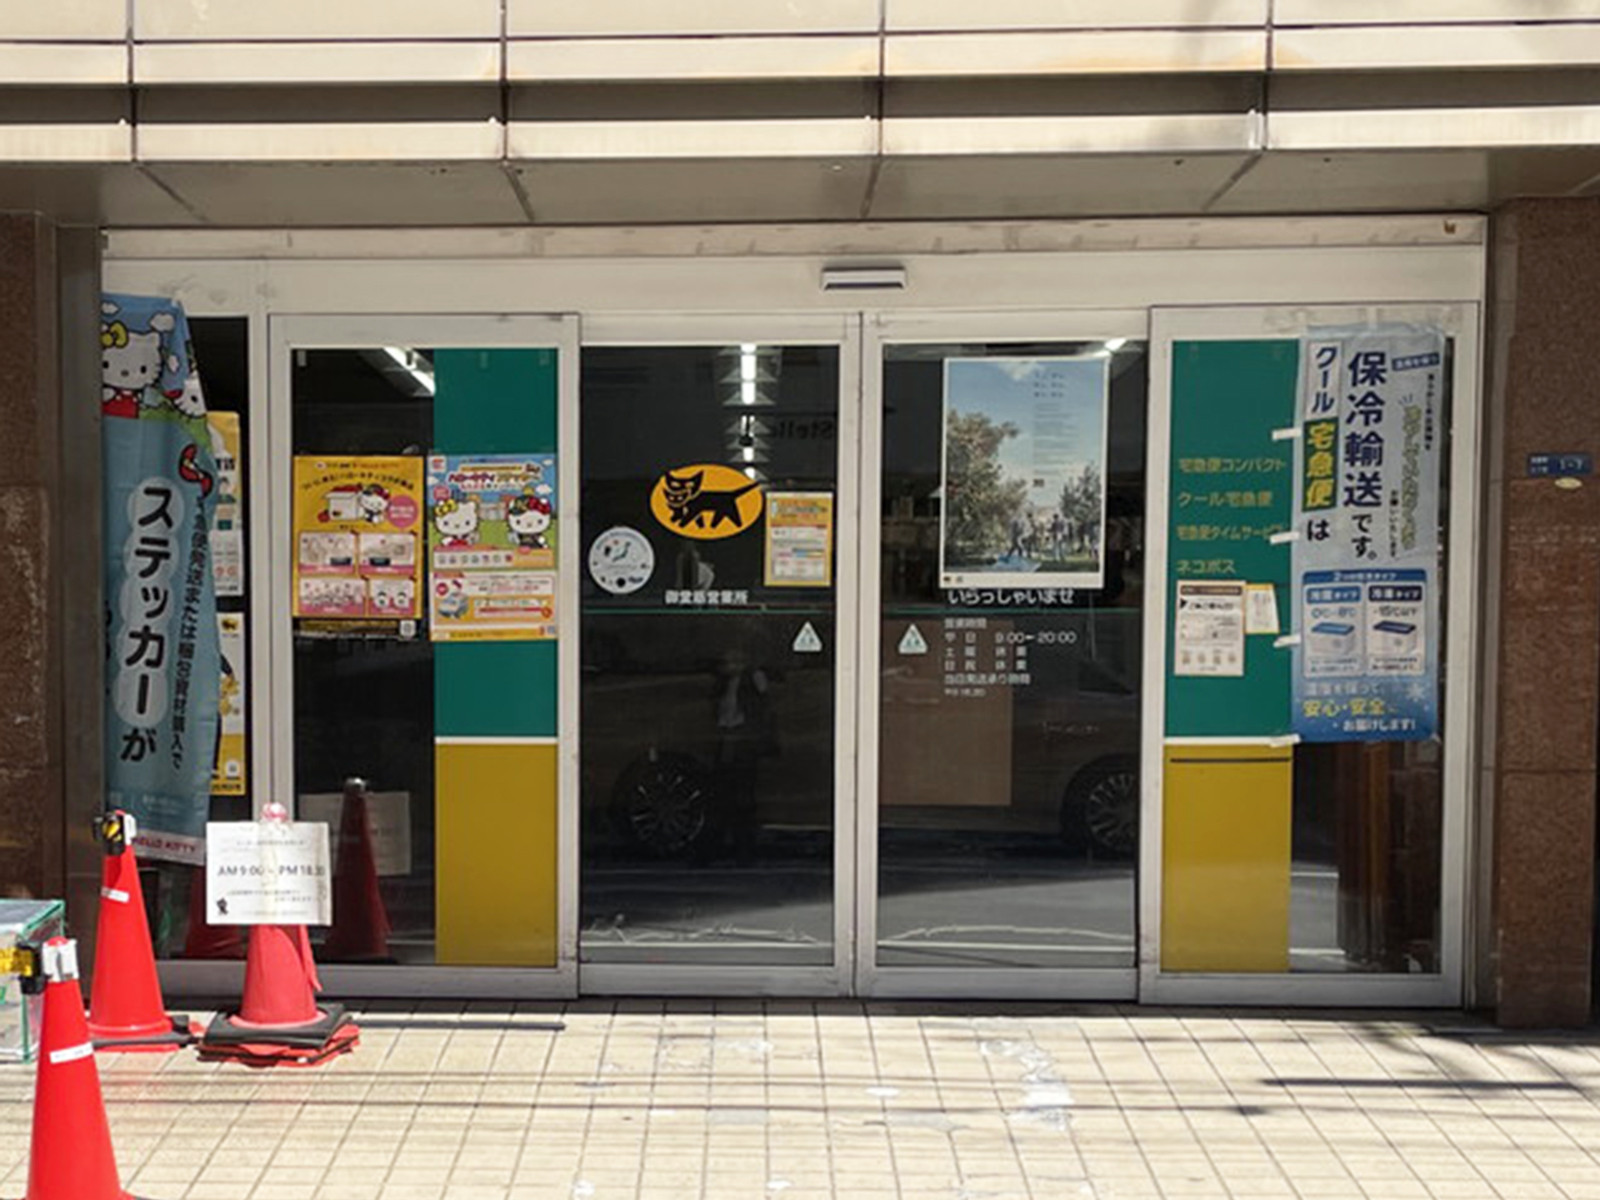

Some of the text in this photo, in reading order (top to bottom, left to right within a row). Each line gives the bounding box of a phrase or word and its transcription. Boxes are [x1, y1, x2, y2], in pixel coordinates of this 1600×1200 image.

[1305, 346, 1338, 541] クール宅急便は
[1343, 351, 1387, 560] 保冷輸送です。
[1178, 457, 1286, 474] 宅急便コンパクト
[1178, 491, 1273, 508] クール宅急便
[1176, 559, 1237, 574] ネコポス
[948, 588, 1074, 605] いらっしゃいませ
[121, 486, 172, 762] ステッカーが
[217, 865, 238, 876] AM
